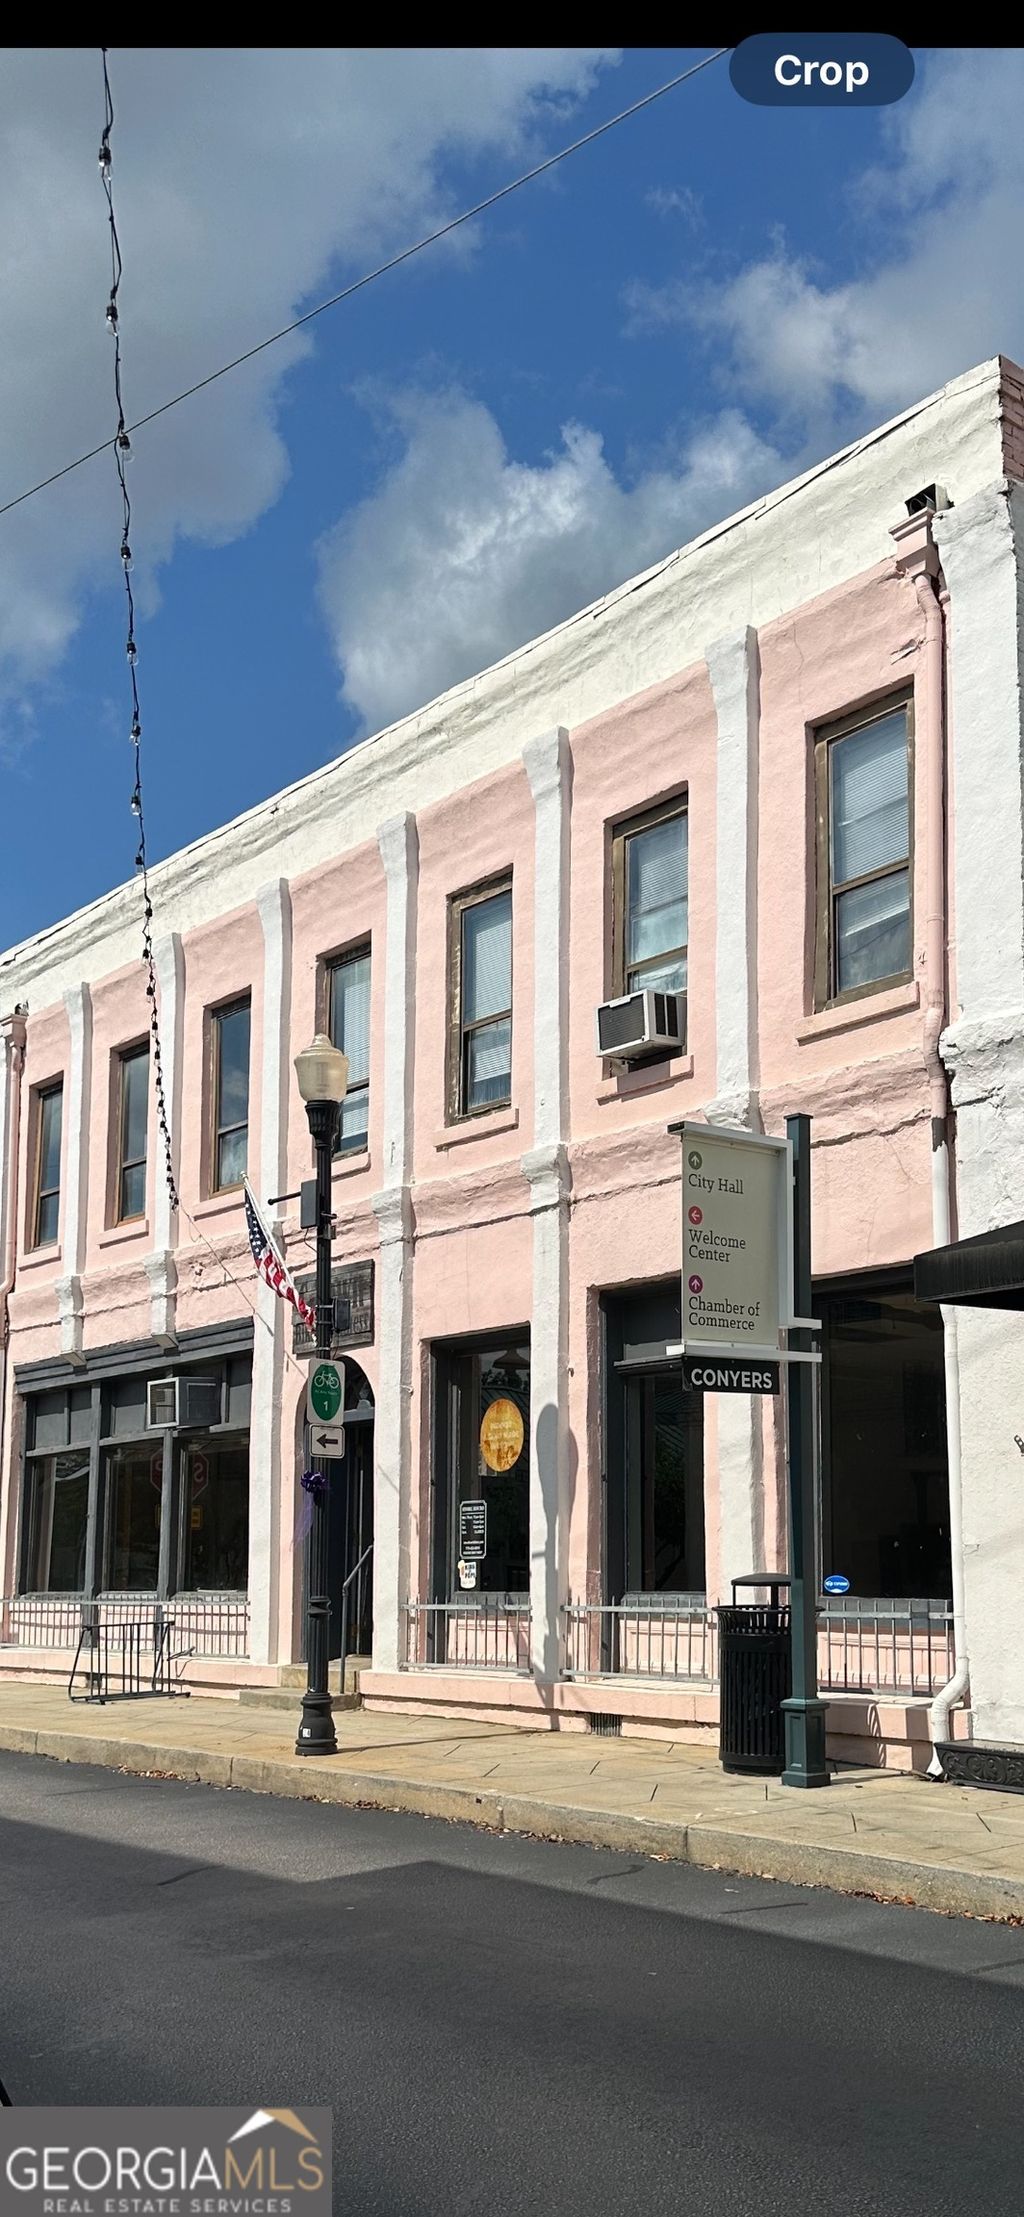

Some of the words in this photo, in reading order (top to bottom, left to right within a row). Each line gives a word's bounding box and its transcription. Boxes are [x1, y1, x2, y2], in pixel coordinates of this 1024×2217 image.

[688, 1173, 715, 1194] City
[718, 1177, 744, 1195] Hall
[688, 1228, 746, 1250] Welcome
[688, 1245, 731, 1263] Center
[688, 1296, 745, 1316] Chamber
[747, 1301, 761, 1317] of
[688, 1312, 755, 1331] Commerce
[690, 1368, 773, 1389] CONYERS
[323, 1400, 329, 1411] 1
